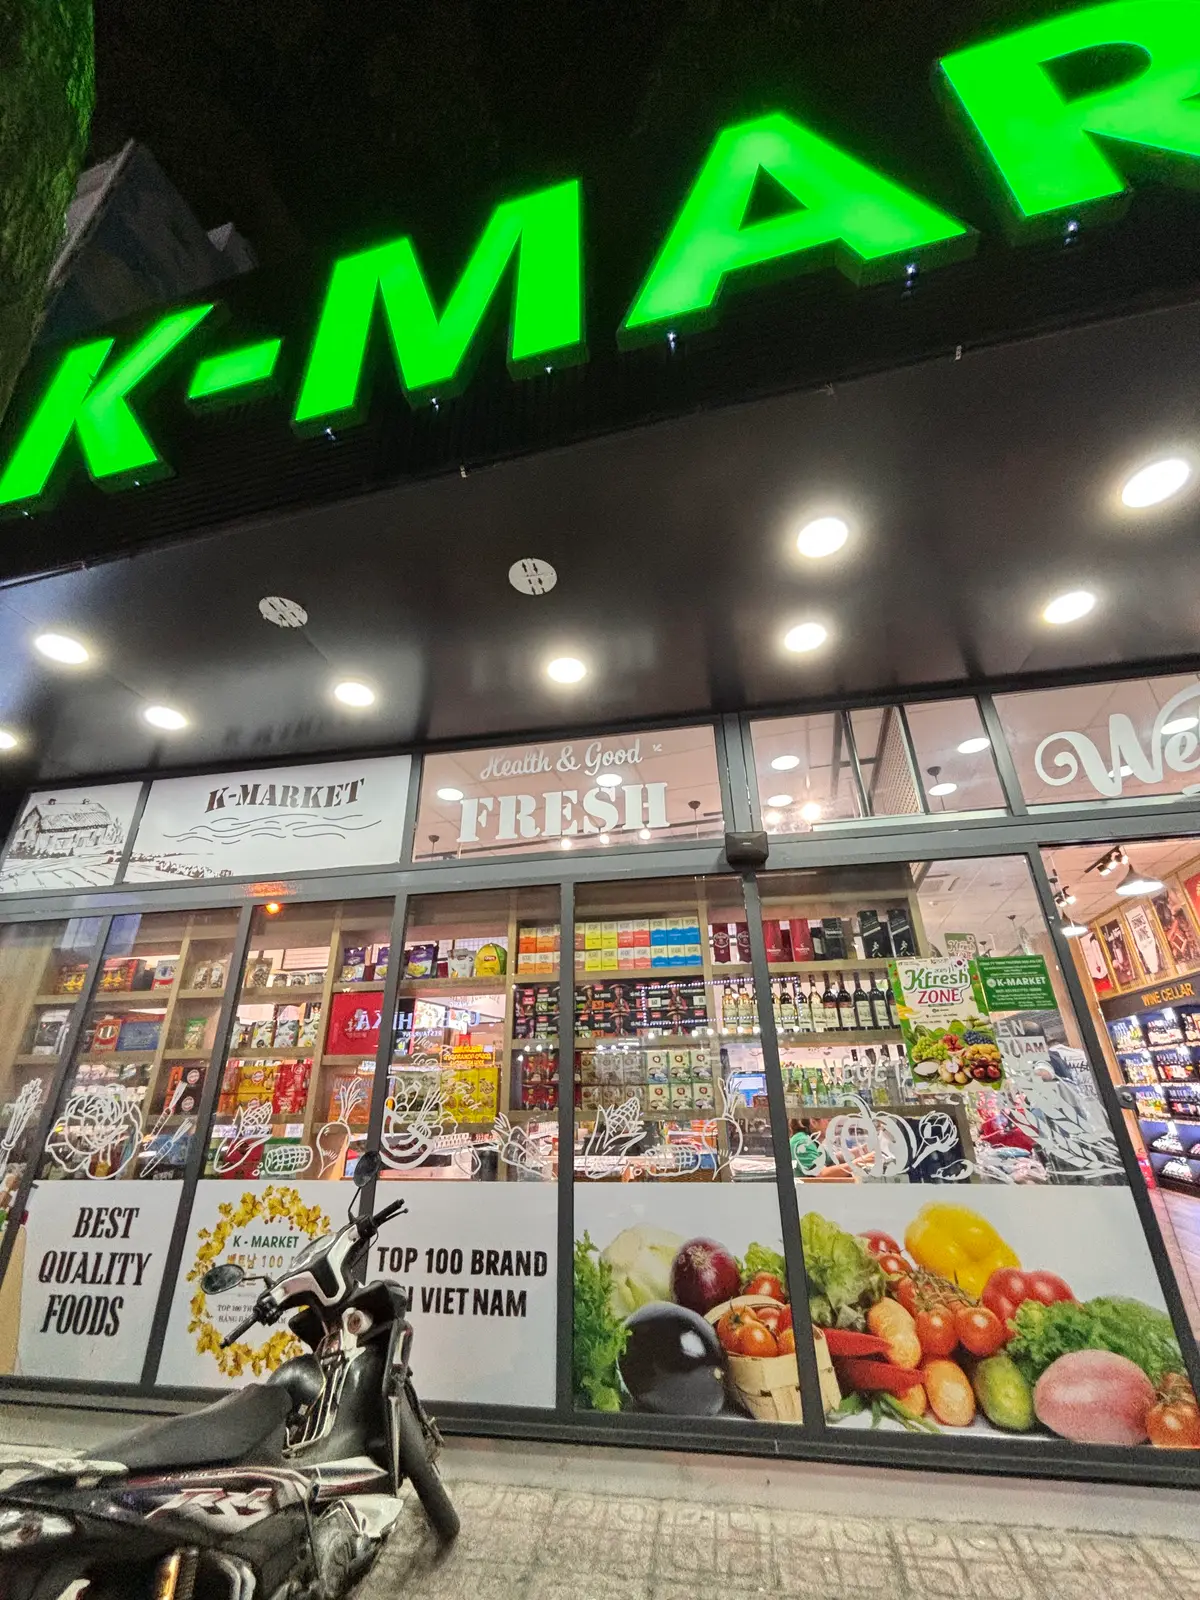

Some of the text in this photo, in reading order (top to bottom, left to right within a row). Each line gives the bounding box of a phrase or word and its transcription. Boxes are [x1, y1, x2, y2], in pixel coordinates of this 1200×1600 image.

[480, 738, 643, 780] Health & Good
[205, 778, 365, 813] K-MARKET
[456, 782, 671, 843] FRESH
[903, 967, 969, 991] Kfresh
[996, 976, 1046, 987] K-MARKET
[1161, 982, 1195, 1002] CELLAR
[918, 988, 961, 1005] ZONE
[72, 1207, 140, 1239] BEST
[251, 1235, 299, 1249] MARKET
[38, 1250, 152, 1286] QUALITY
[262, 1255, 284, 1268] 100
[377, 1246, 548, 1277] TOP 100 BRAND
[40, 1294, 124, 1337] FOODS
